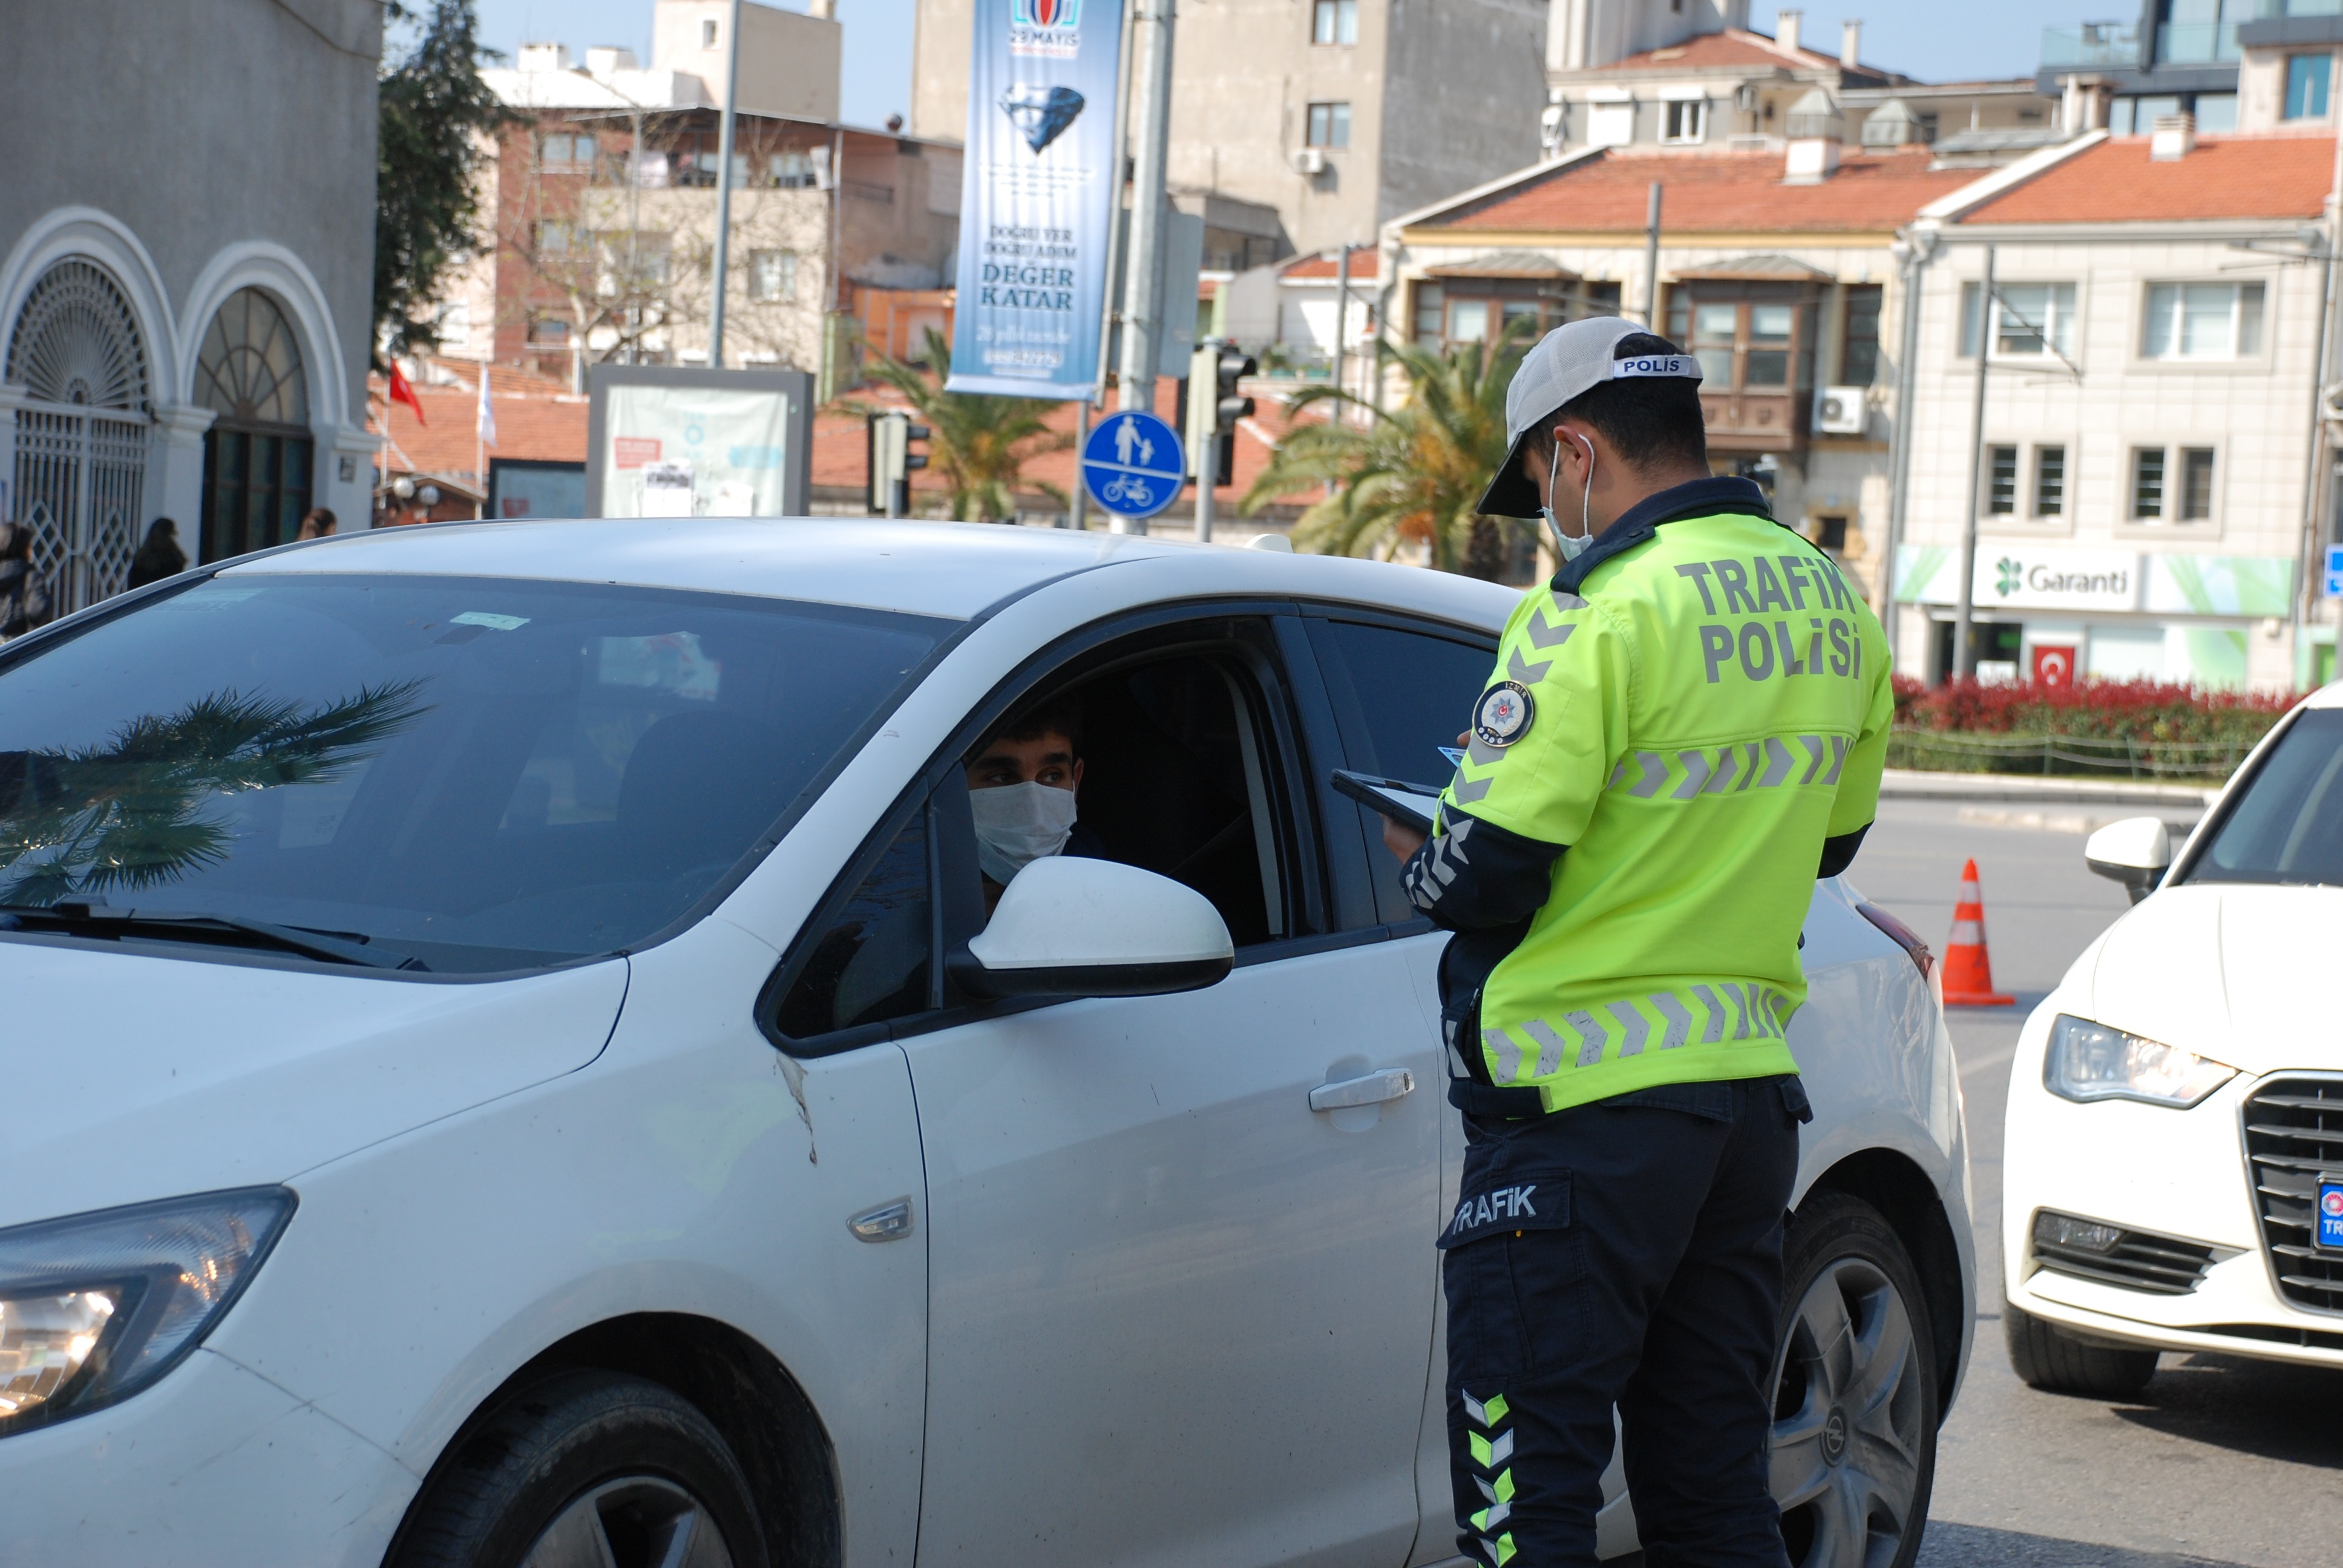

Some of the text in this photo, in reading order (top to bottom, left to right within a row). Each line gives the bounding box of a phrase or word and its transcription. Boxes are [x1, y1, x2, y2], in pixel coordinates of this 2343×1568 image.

[982, 261, 1074, 287] DEĞER
[981, 287, 1072, 310] KATAR
[2028, 564, 2127, 594] Garanti
[2323, 1218, 2343, 1235] TR
